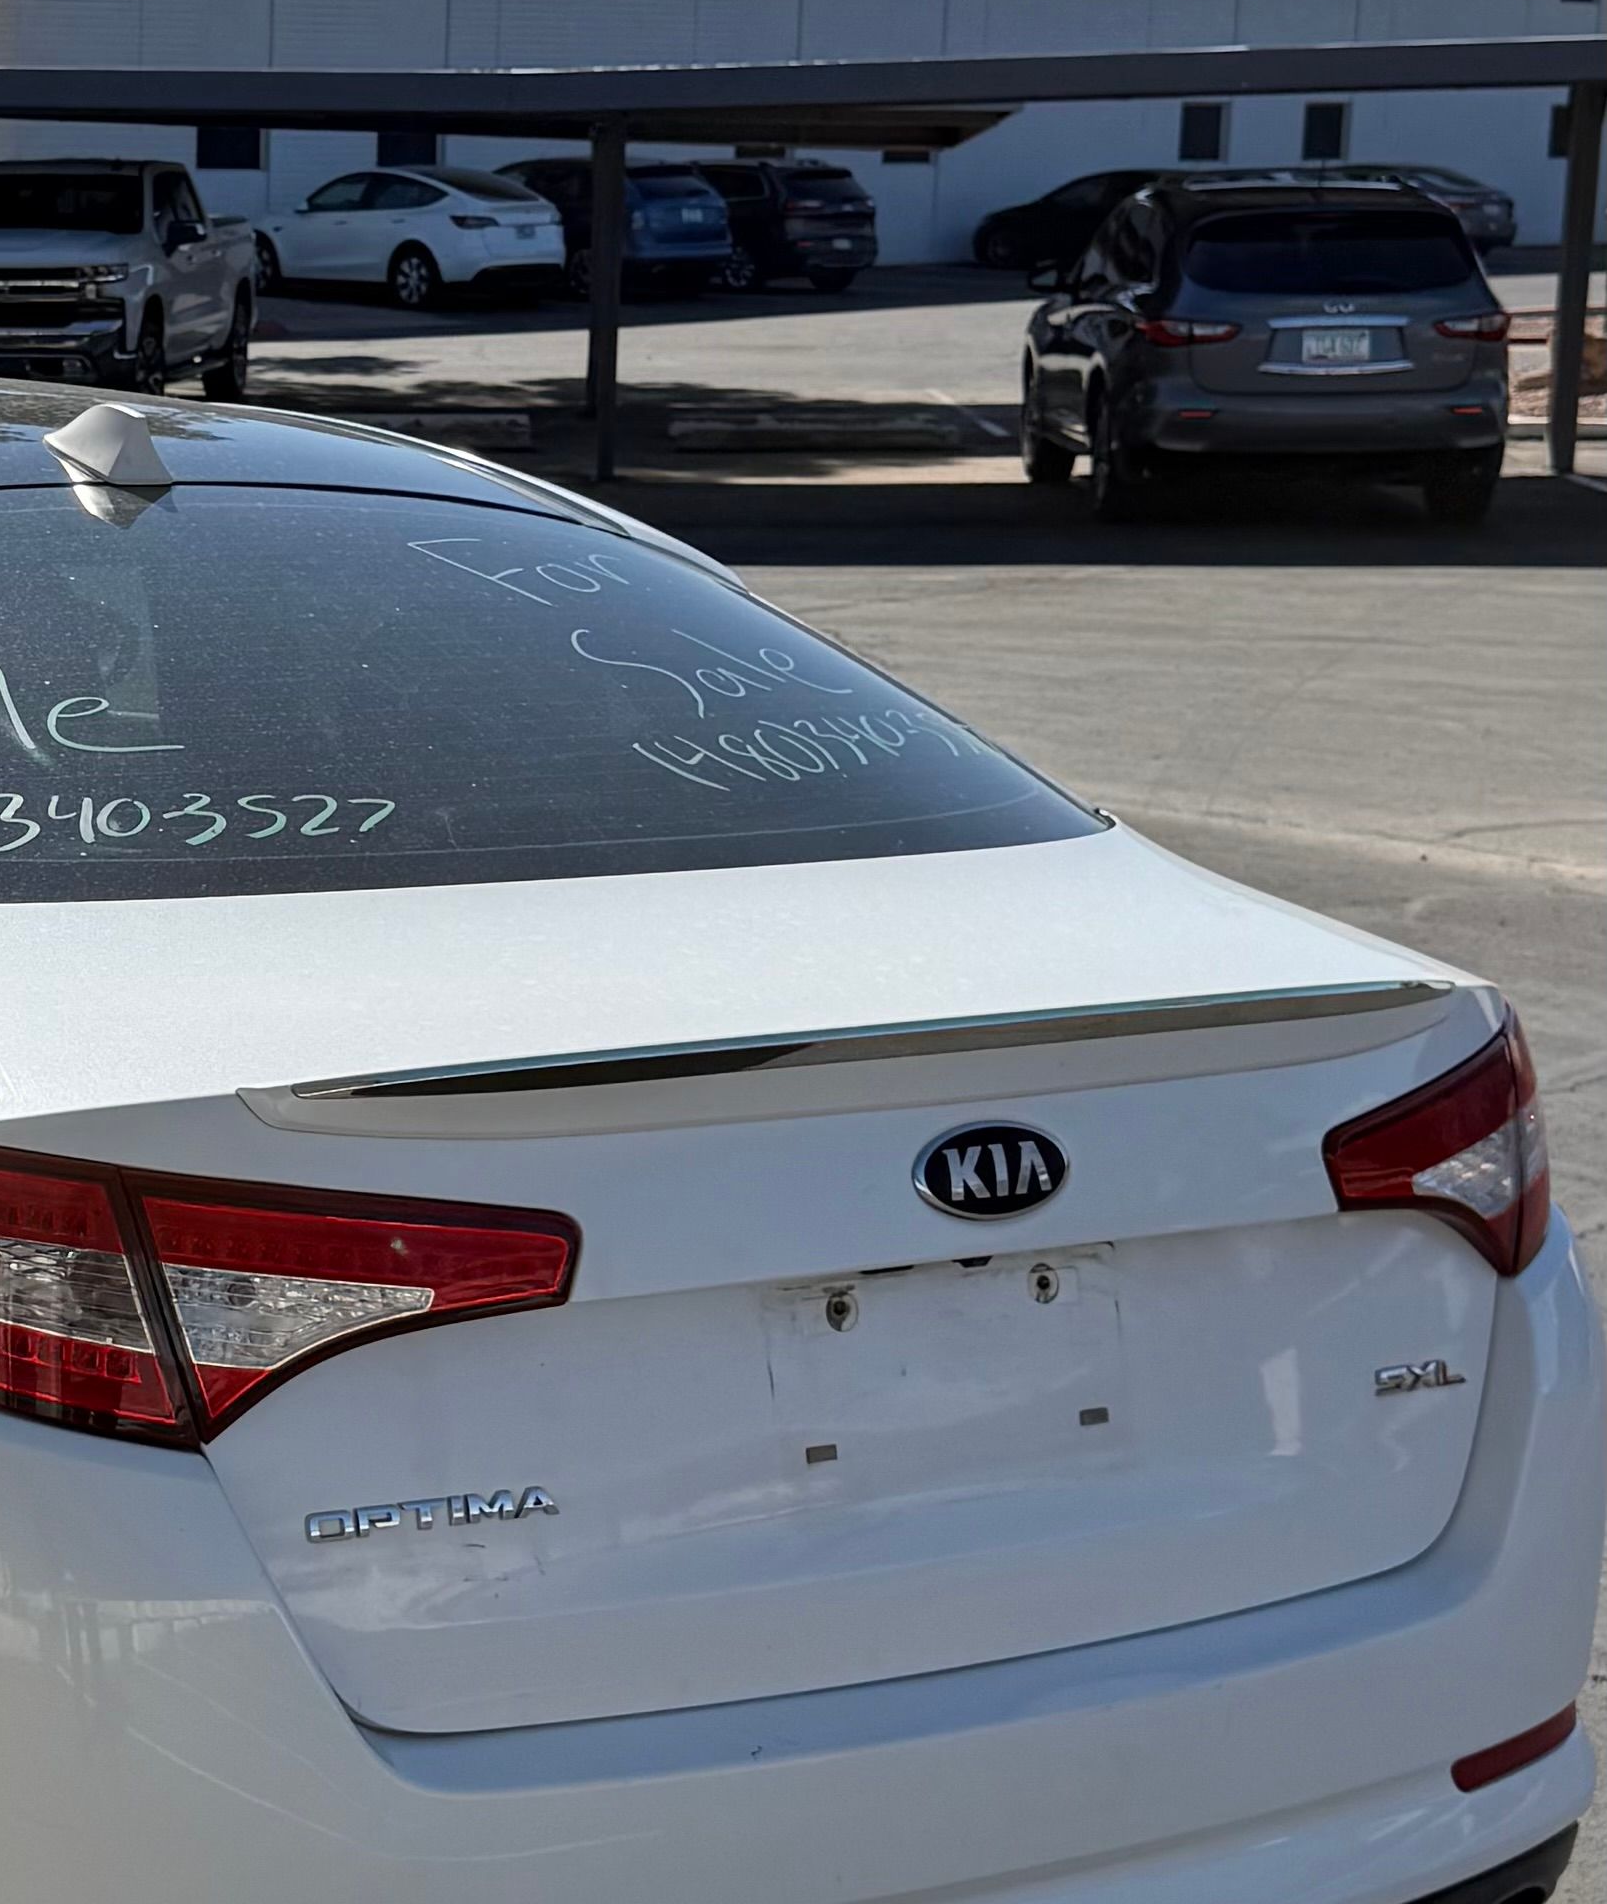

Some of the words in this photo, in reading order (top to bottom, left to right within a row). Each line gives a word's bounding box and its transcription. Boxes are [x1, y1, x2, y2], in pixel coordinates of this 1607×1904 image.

[405, 536, 633, 608] For
[570, 627, 854, 719] Sale
[942, 1140, 1053, 1202] KIA
[1374, 1359, 1467, 1397] SXL
[305, 1485, 561, 1544] OPTIMA
